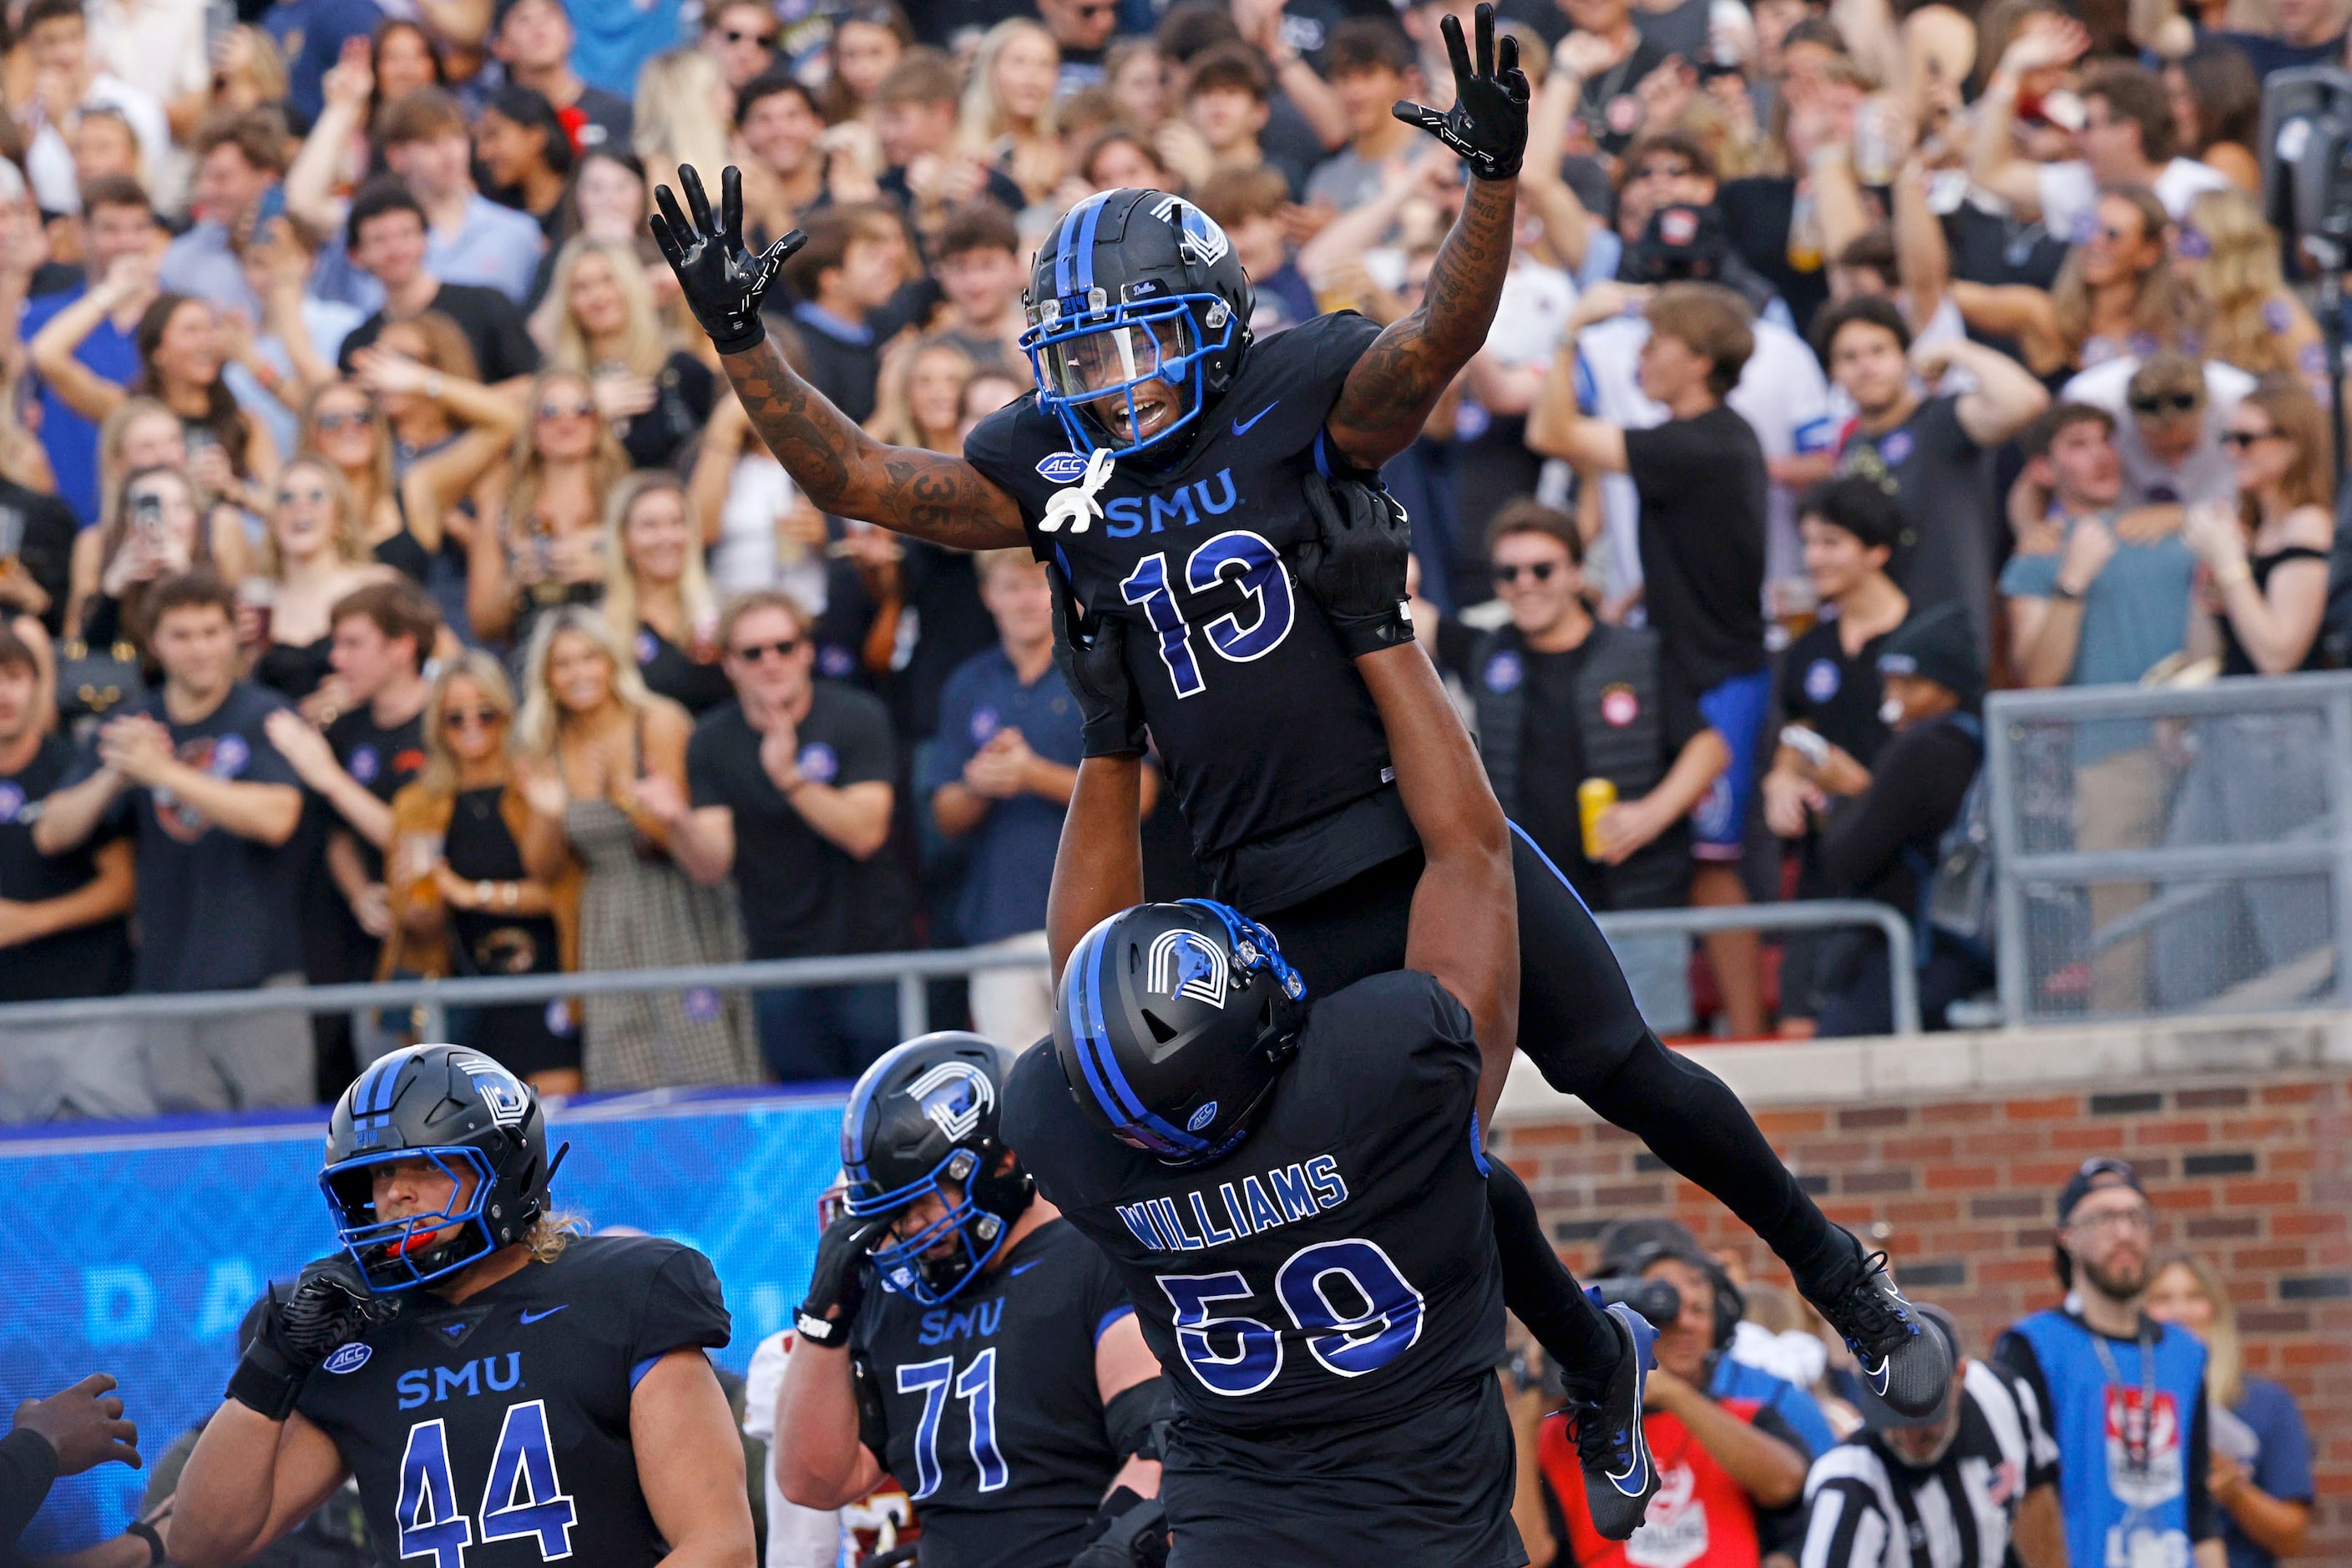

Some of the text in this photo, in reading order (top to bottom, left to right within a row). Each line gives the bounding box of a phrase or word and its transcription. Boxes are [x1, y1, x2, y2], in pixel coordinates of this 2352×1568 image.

[1062, 296, 1087, 314] 214
[1044, 458, 1083, 472] ACC
[1104, 467, 1237, 539] SMU
[1119, 529, 1295, 700] 13
[1115, 1154, 1349, 1252] WILLIAMS
[918, 1296, 1005, 1346] SMU
[1155, 1238, 1426, 1397] 59
[332, 1348, 365, 1366] ACC
[396, 1351, 522, 1411] SMU
[896, 1346, 1009, 1501] 71
[395, 1399, 579, 1568] 44
